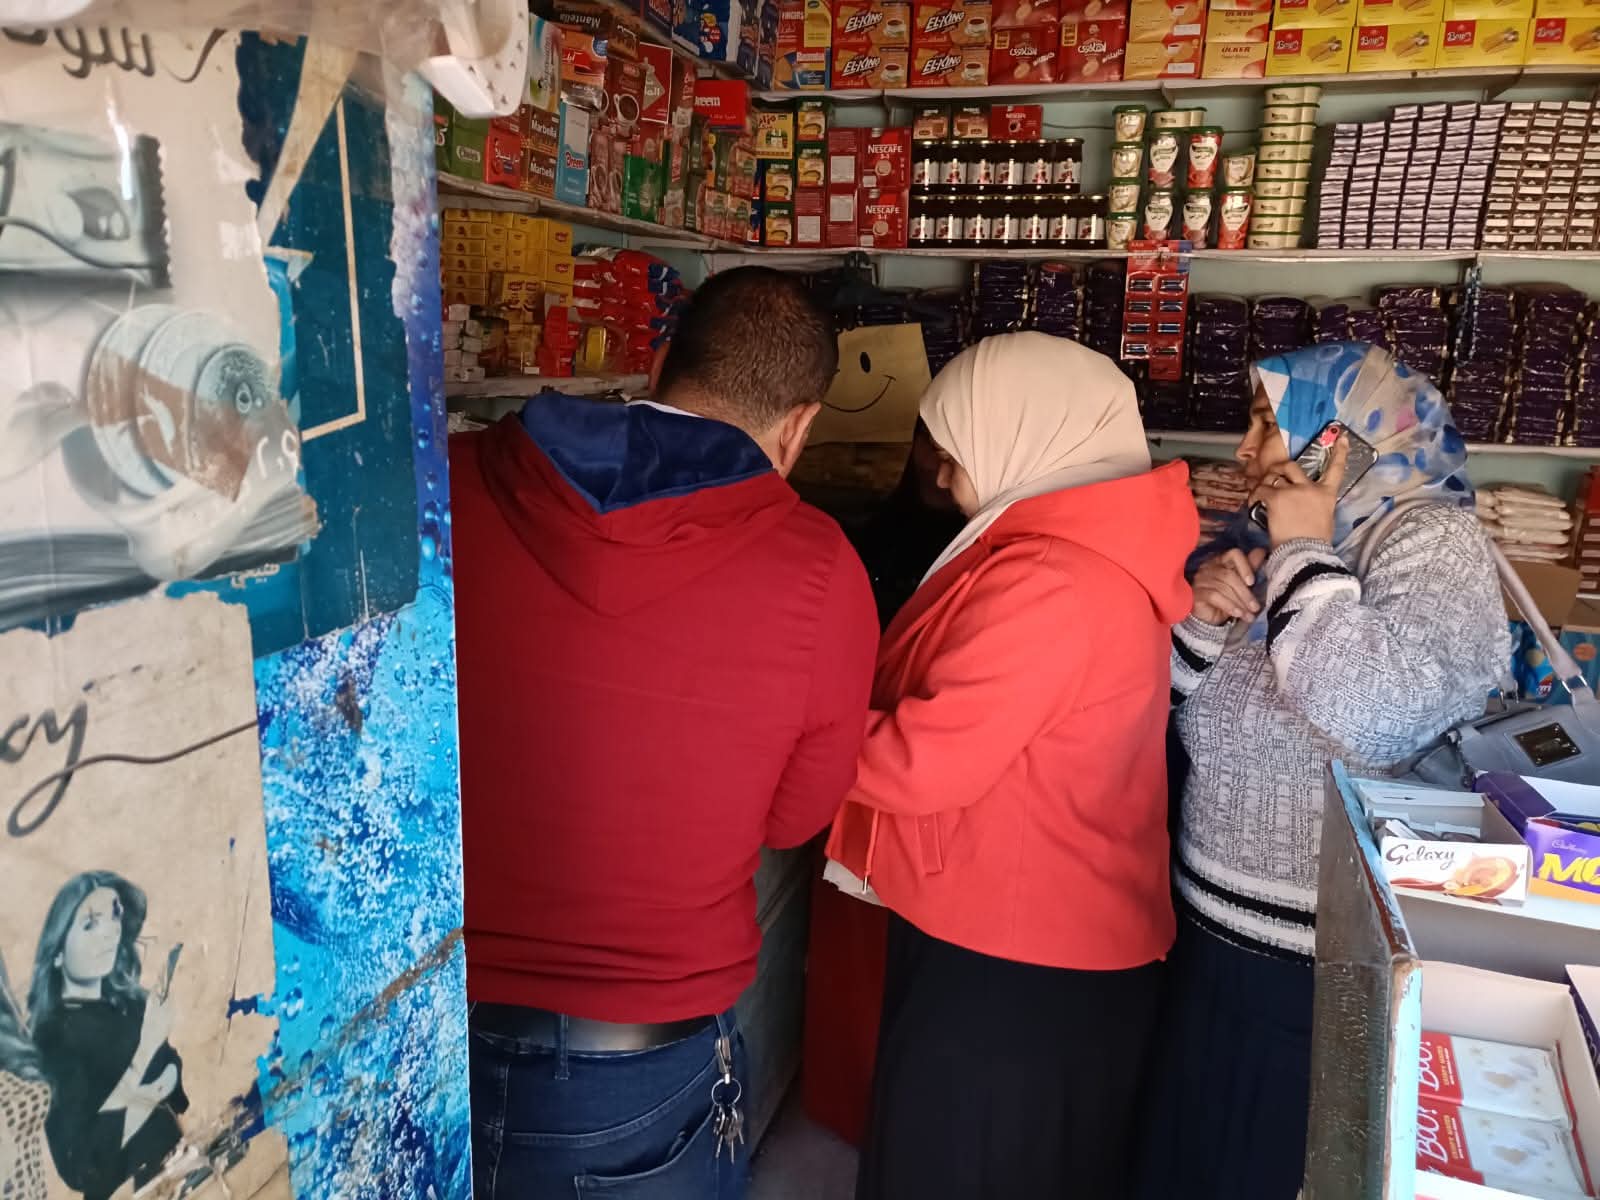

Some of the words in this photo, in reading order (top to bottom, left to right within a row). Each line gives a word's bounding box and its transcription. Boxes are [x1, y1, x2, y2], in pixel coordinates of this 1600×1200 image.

[842, 56, 881, 77] EL-KING
[921, 55, 962, 76] EL-KING
[1386, 843, 1456, 871] Galaxy
